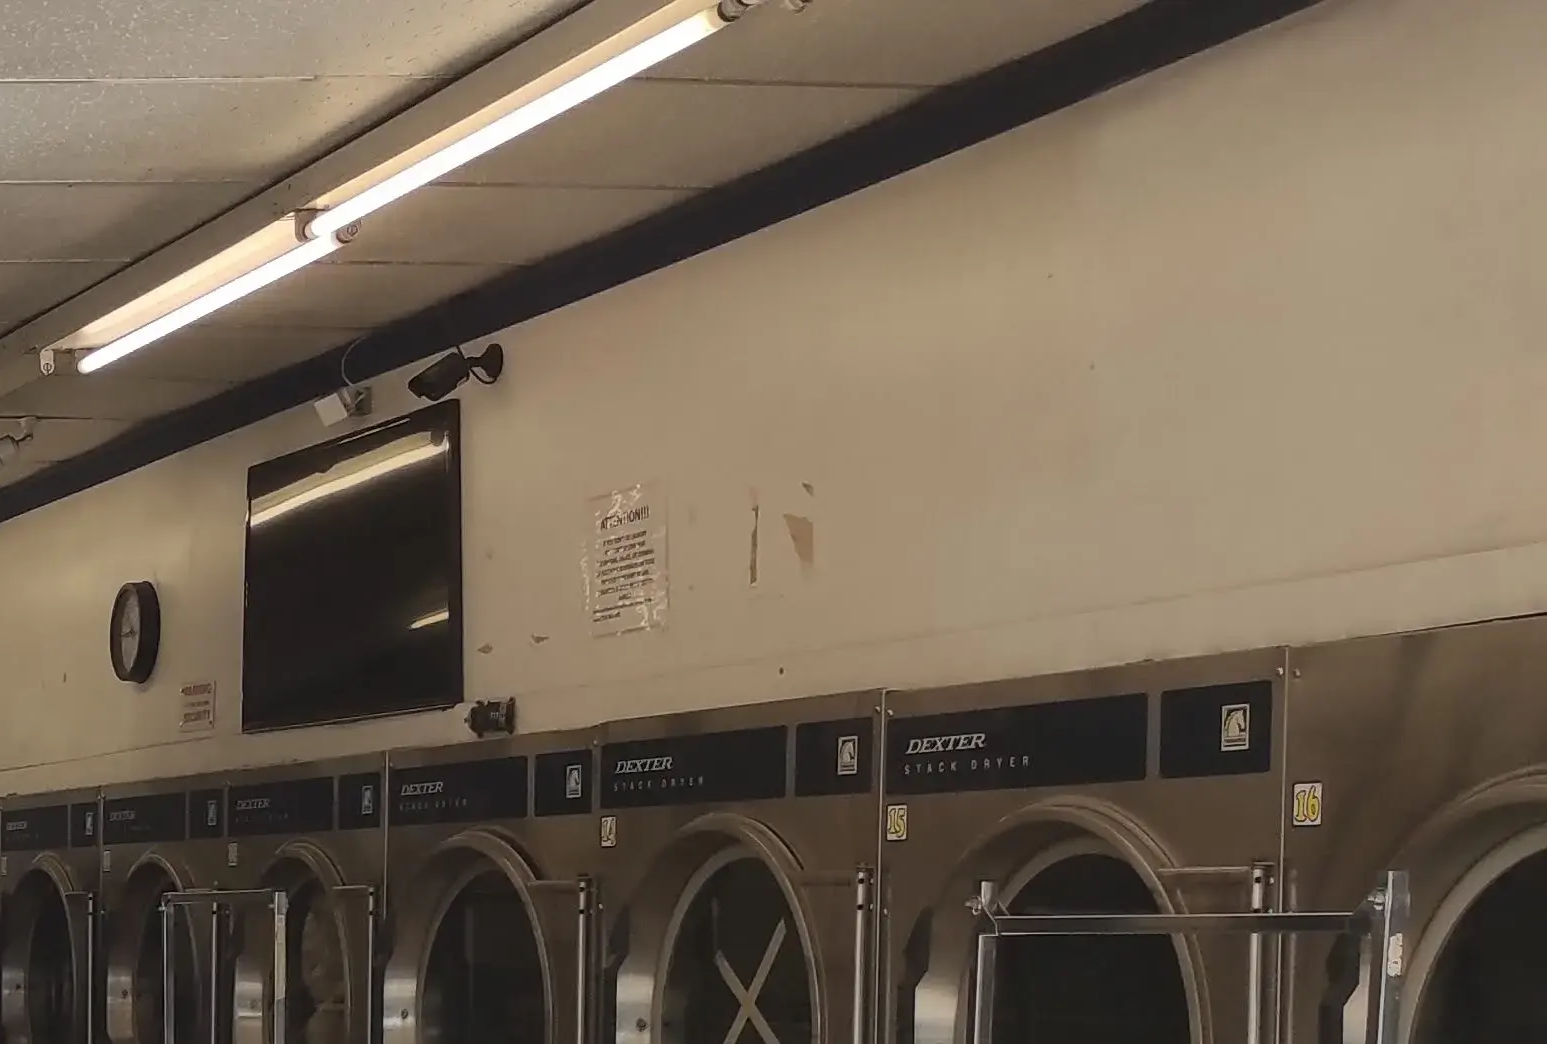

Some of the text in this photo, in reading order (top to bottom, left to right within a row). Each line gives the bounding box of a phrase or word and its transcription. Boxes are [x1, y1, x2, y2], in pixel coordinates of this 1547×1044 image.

[906, 733, 986, 754] DEXTER
[614, 756, 673, 774] DEXTER
[904, 756, 1030, 775] STACK DRYER
[401, 782, 444, 796] DEXTER
[1295, 785, 1320, 822] 16
[888, 807, 906, 838] 15
